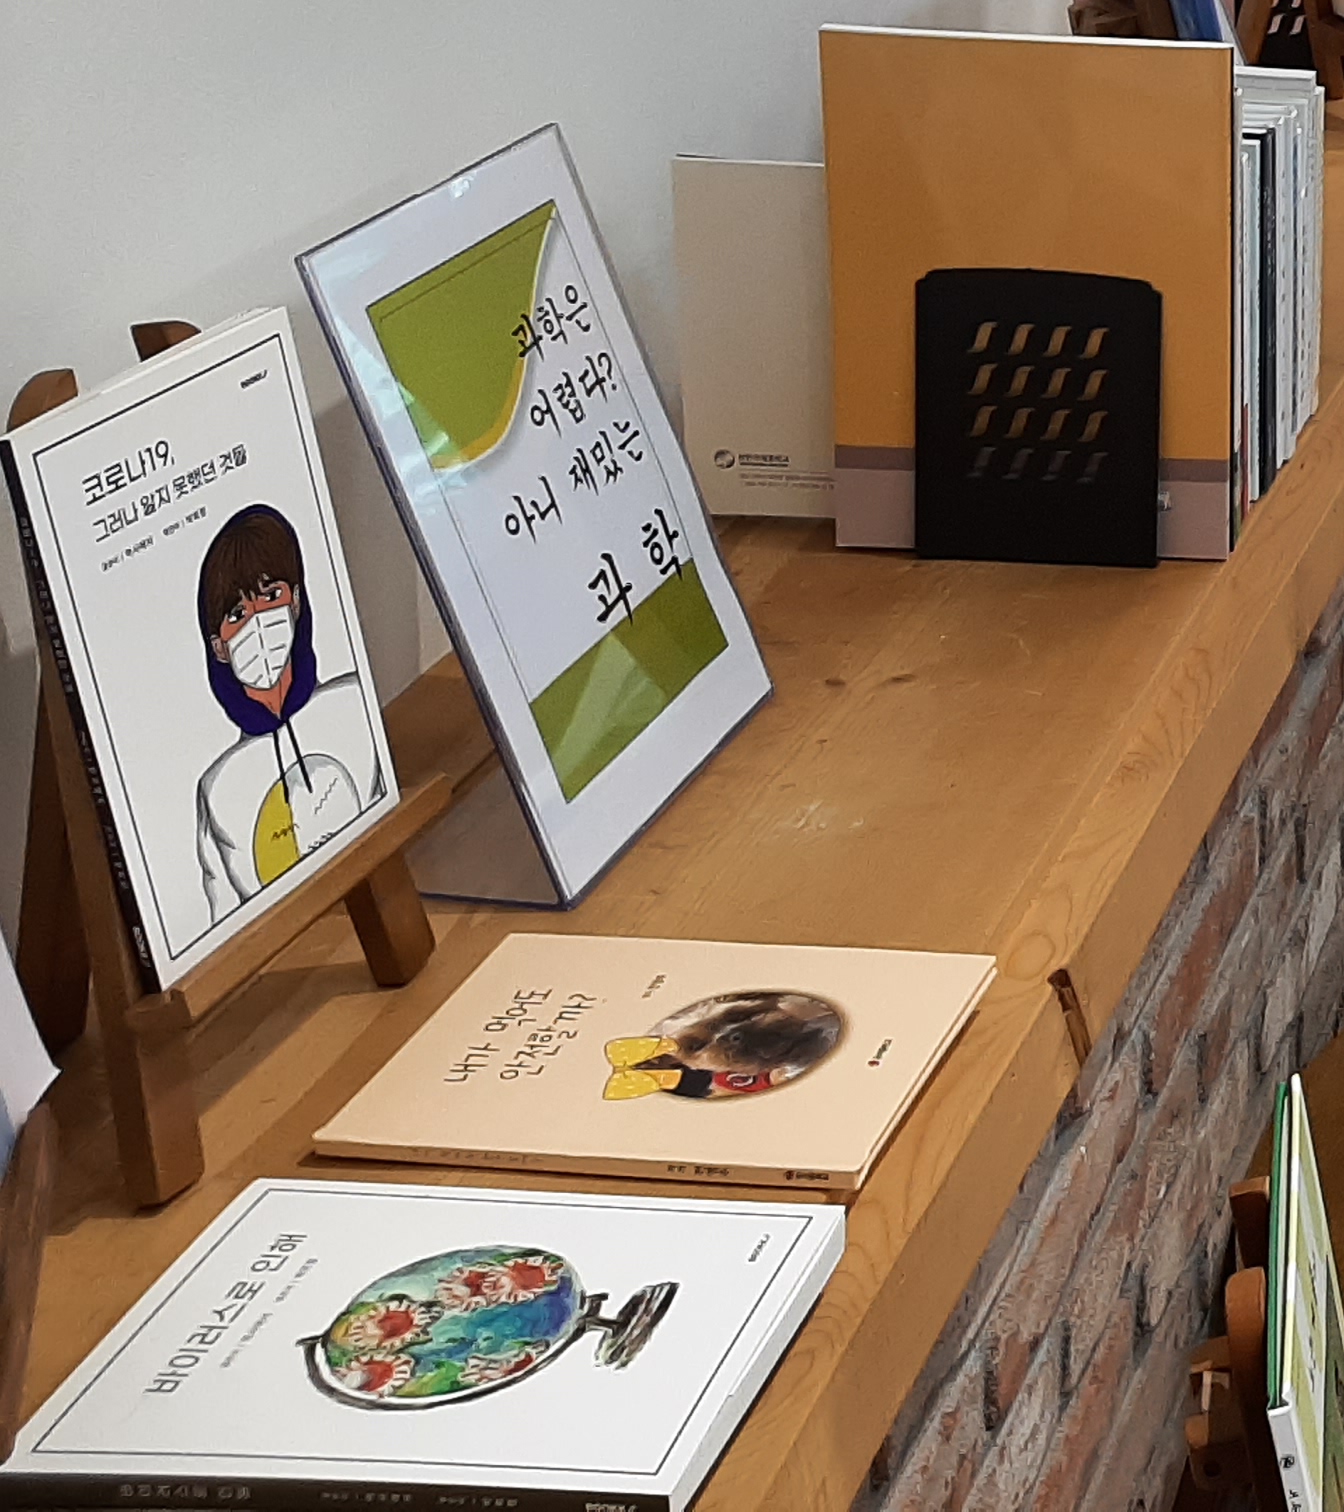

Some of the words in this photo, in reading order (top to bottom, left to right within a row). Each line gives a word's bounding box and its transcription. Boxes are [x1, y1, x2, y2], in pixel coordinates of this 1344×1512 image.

[511, 284, 592, 361] 과학은
[529, 352, 618, 437] 어렵다?
[82, 440, 175, 506] 코로나19,
[504, 476, 563, 544] 아니
[568, 418, 644, 497] 재밌는
[92, 501, 139, 543] 그러나
[444, 1041, 502, 1085] 내가
[483, 986, 553, 1037] 먹어도
[499, 993, 598, 1081] 안전할까?
[143, 1276, 267, 1396] 바이러스로
[249, 1232, 308, 1290] 인해
